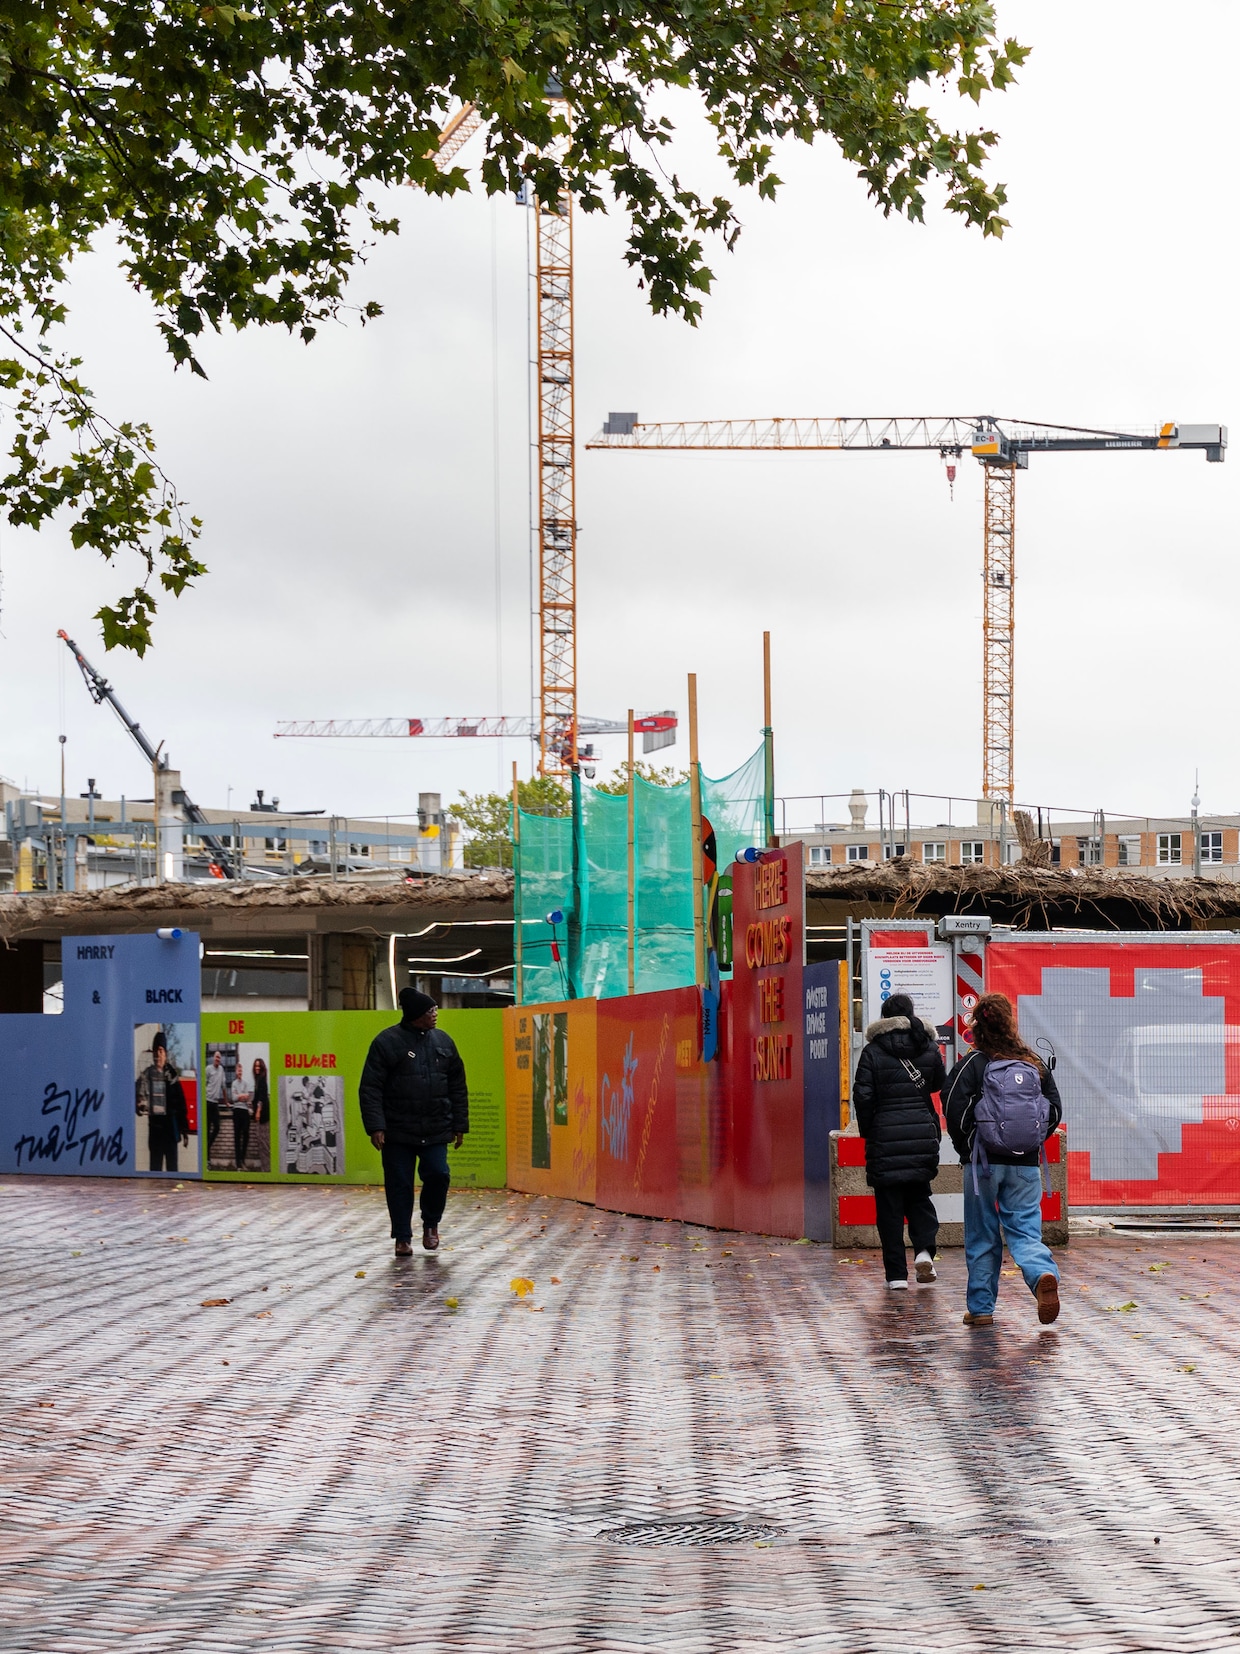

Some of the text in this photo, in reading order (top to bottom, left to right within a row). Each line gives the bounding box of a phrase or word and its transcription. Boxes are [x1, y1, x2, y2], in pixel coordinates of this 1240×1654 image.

[975, 435, 995, 443] EC-B
[754, 858, 788, 910] HERE
[955, 921, 981, 930] Xentry
[745, 916, 792, 969] COMES
[77, 945, 115, 960] HARRY
[92, 988, 183, 1005] & BLACK
[757, 976, 785, 1024] THE
[228, 1019, 245, 1035] DE
[809, 1037, 829, 1060] POORT
